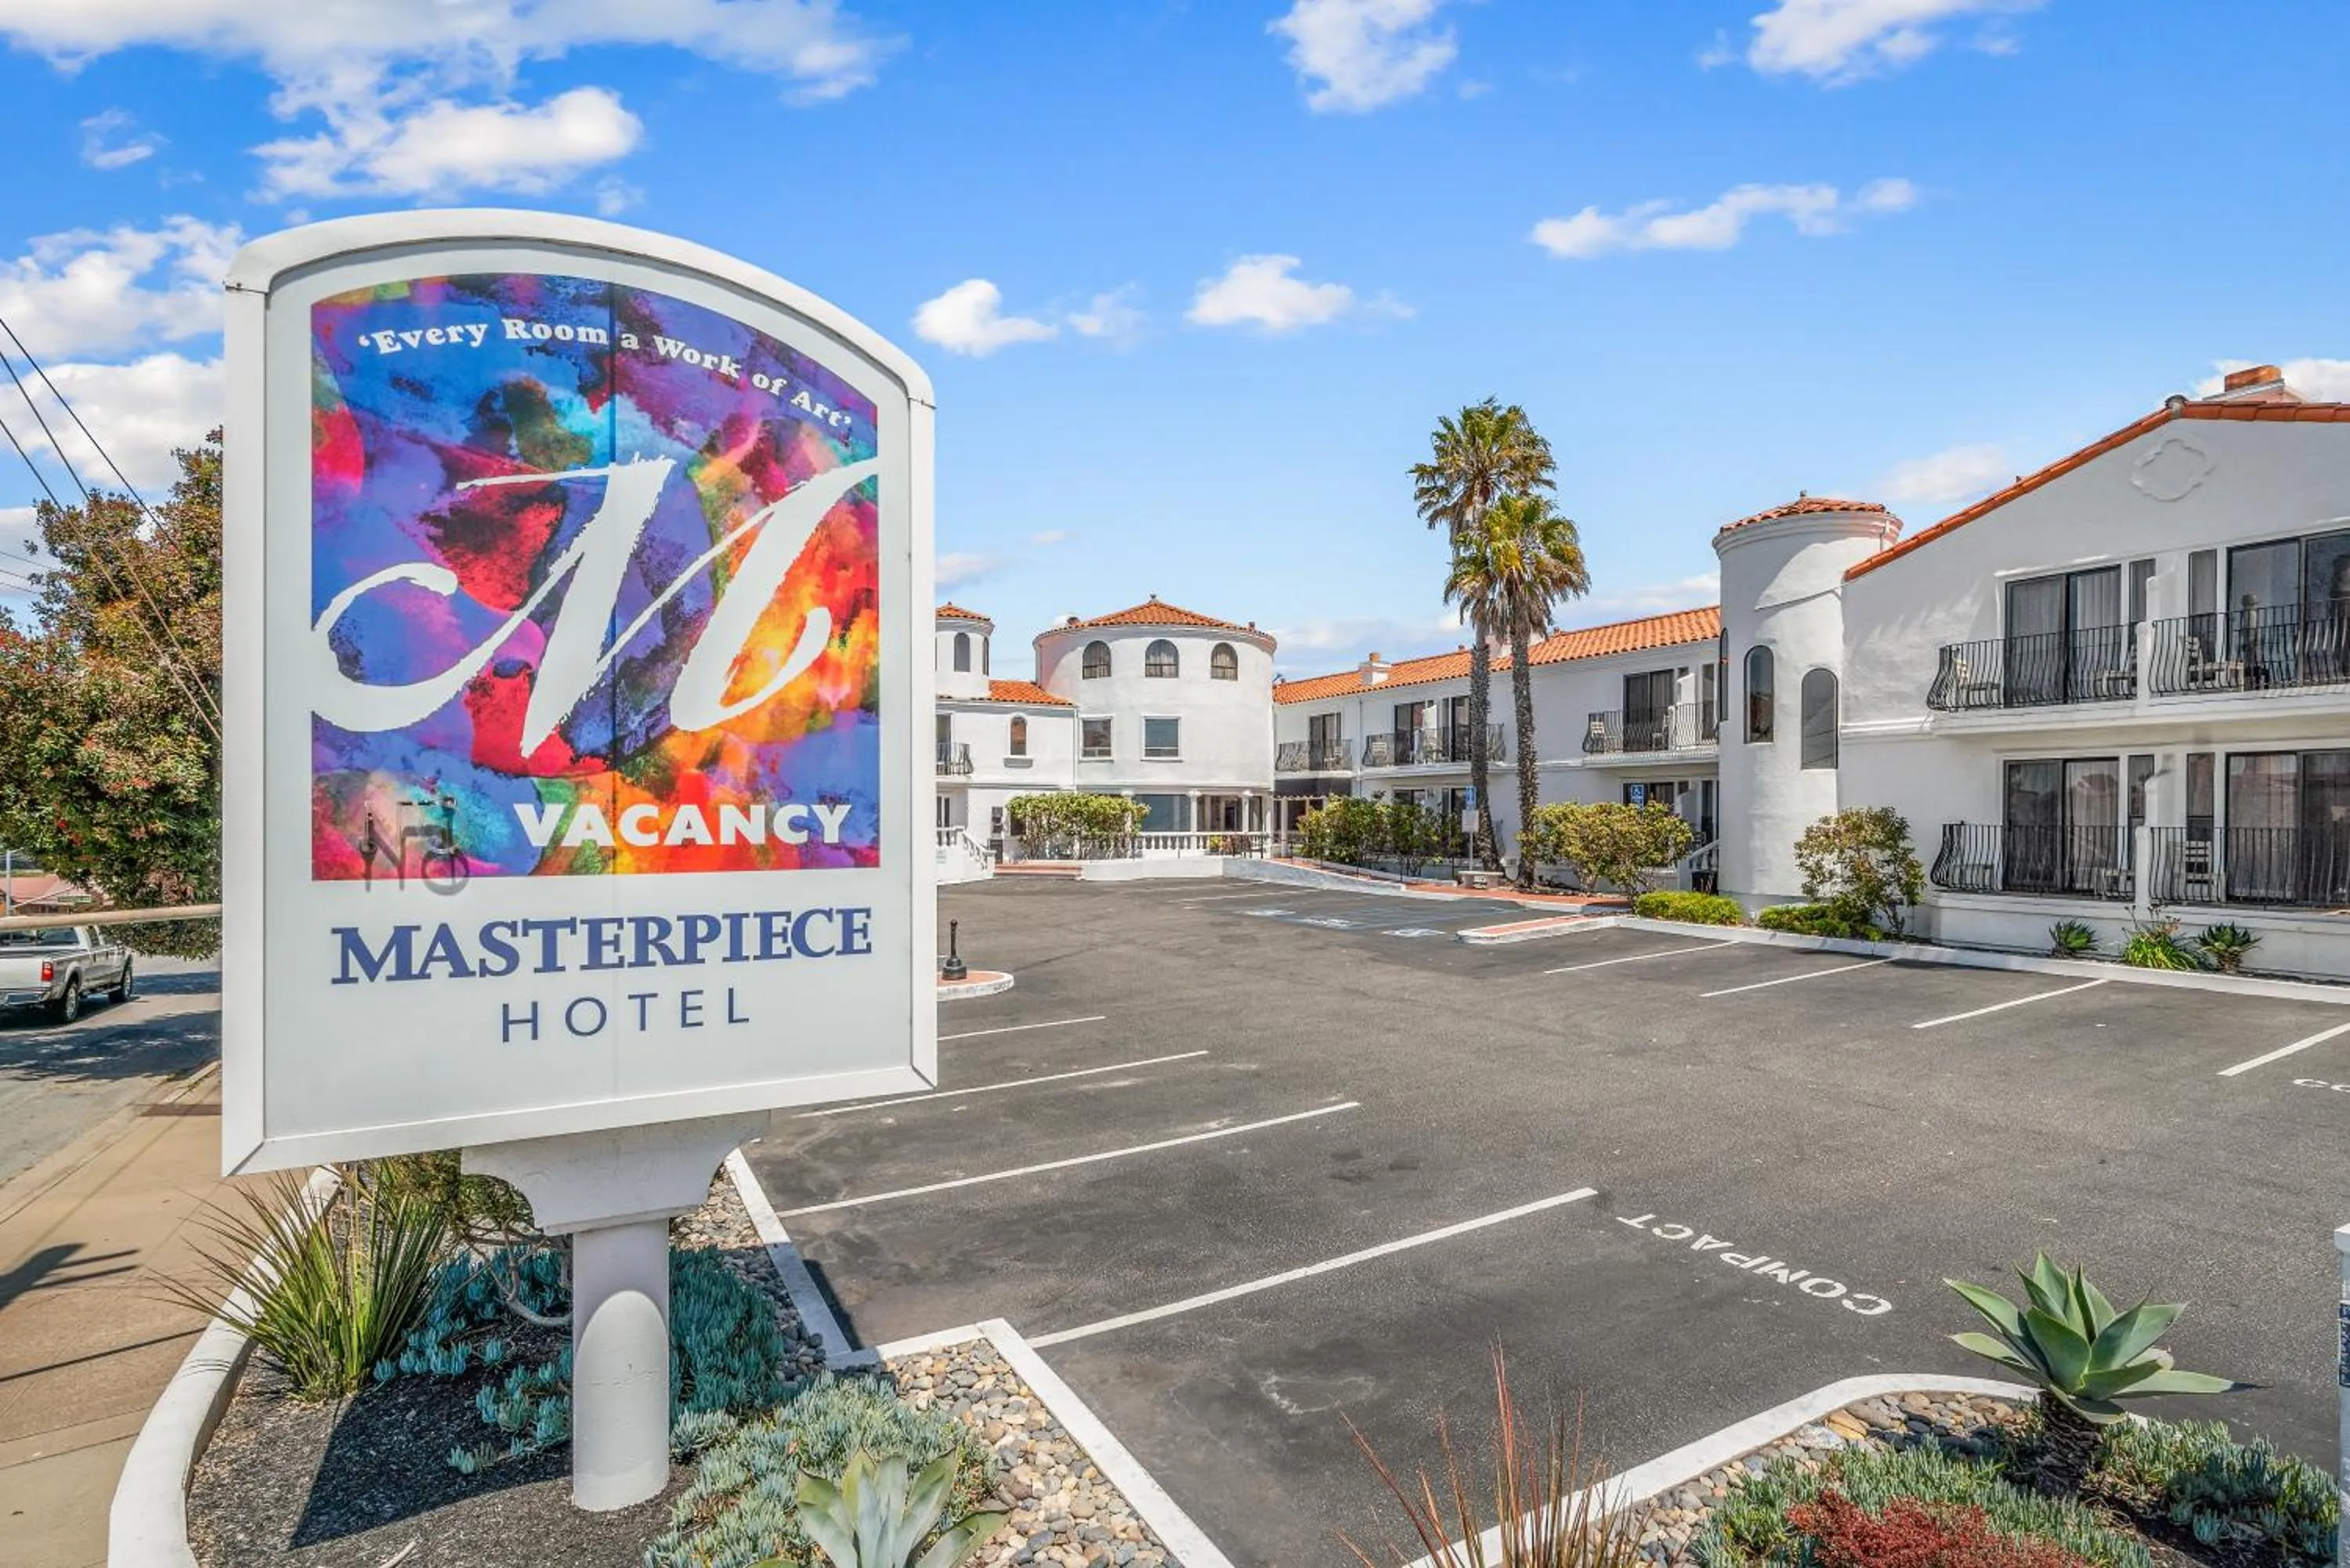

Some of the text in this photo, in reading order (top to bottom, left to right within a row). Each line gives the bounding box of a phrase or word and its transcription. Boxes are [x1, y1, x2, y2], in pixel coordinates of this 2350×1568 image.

[503, 317, 609, 345] Room
[622, 332, 639, 349] a
[652, 336, 741, 378] Work
[752, 371, 787, 394] of
[513, 804, 851, 847] VACANCY
[331, 907, 872, 985] MASTERPIECE
[501, 987, 750, 1042] HOTEL
[1616, 1213, 1892, 1315] COMPACT
